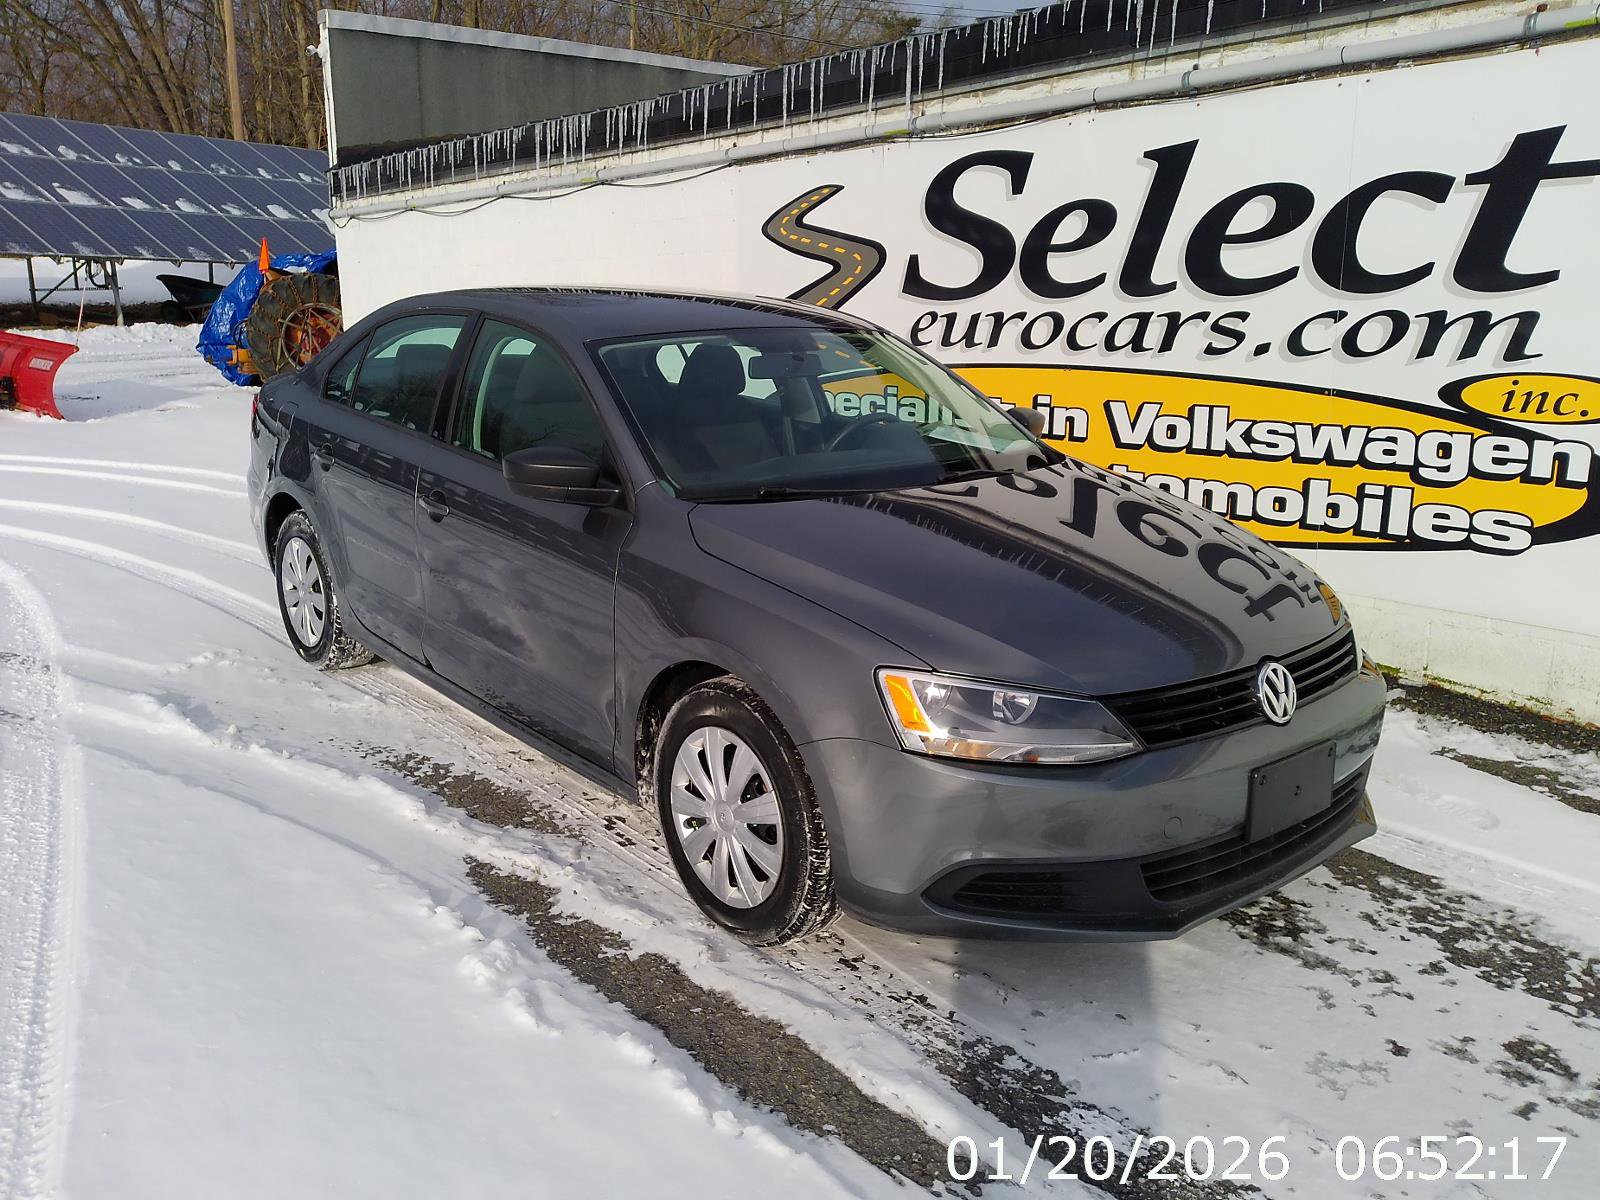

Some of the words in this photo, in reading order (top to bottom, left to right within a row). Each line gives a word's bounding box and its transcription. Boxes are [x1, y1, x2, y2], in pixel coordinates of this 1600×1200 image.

[903, 124, 1600, 302] Select
[909, 309, 1543, 362] eurocars.com
[1501, 379, 1590, 417] inc.
[1033, 394, 1089, 442] in
[1105, 400, 1592, 485] Volkswagen
